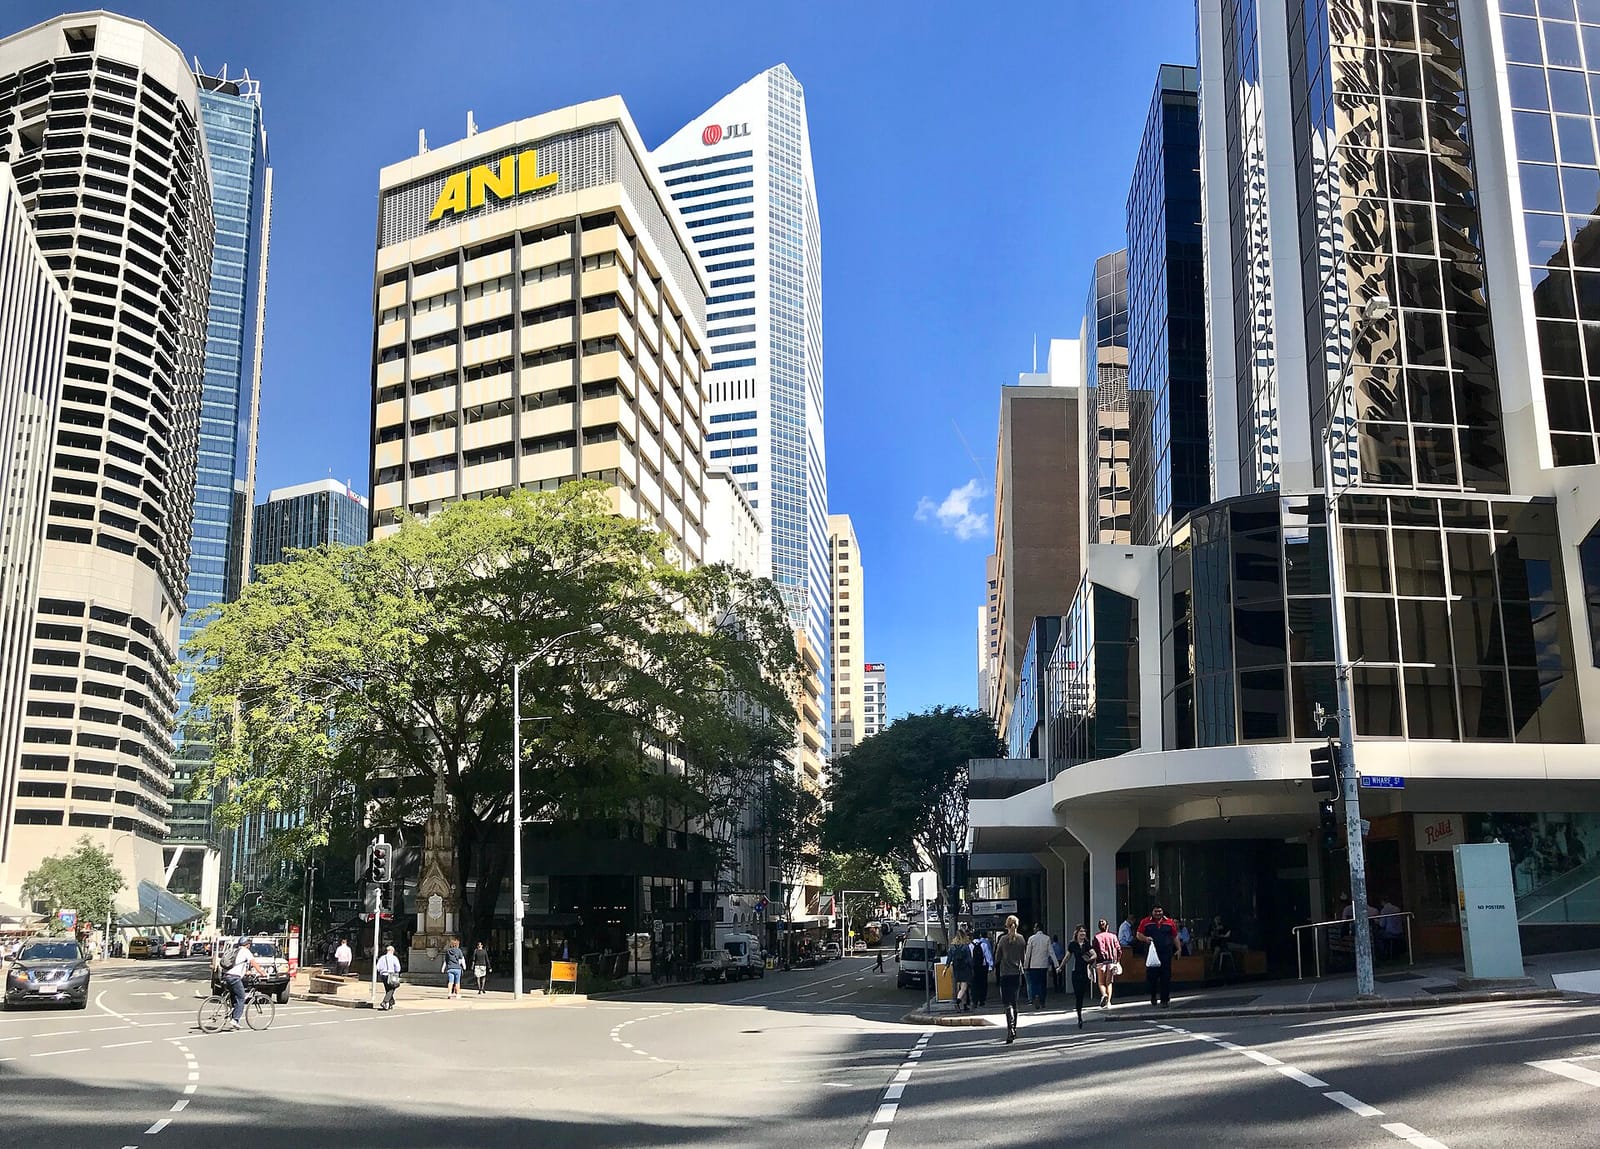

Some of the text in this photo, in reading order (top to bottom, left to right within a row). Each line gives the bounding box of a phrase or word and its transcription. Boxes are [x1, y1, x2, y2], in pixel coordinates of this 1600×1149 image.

[722, 122, 752, 140] JLL
[429, 149, 559, 222] ANL
[1371, 776, 1391, 784] WHARF
